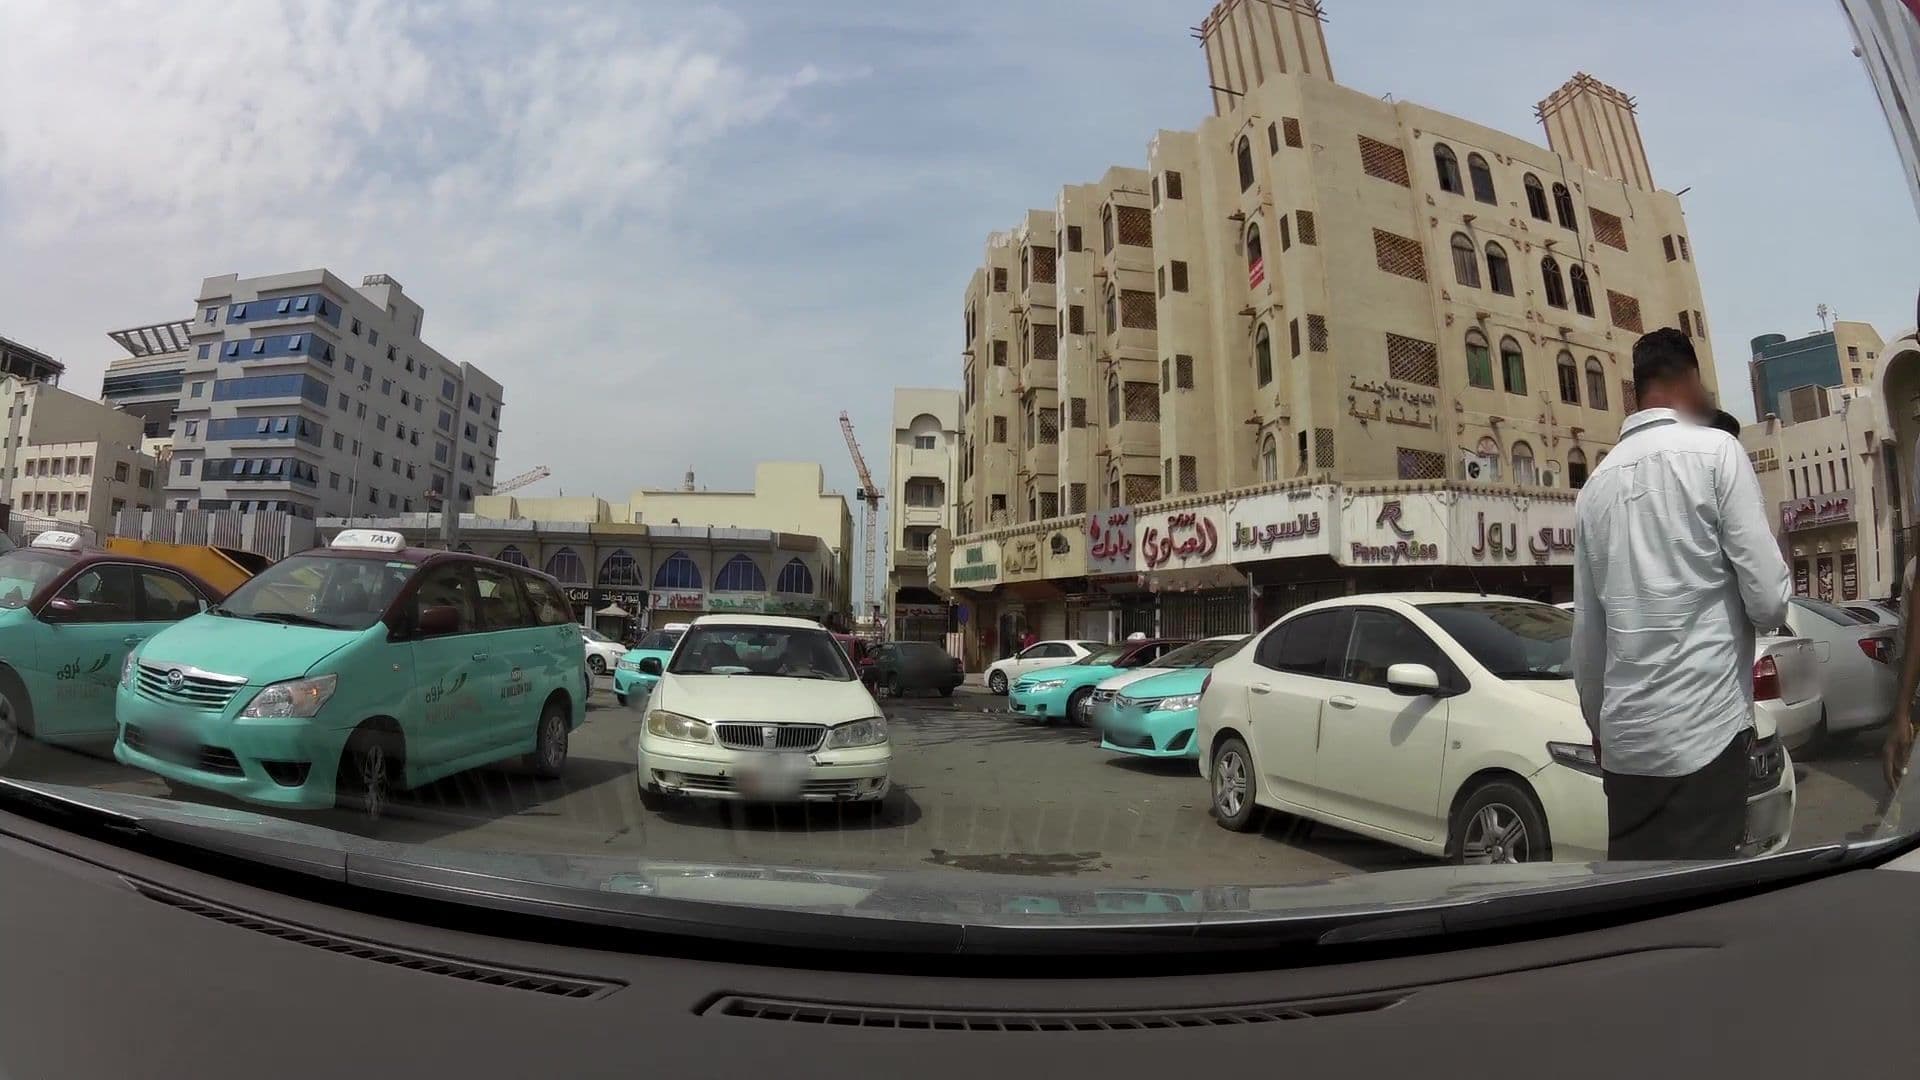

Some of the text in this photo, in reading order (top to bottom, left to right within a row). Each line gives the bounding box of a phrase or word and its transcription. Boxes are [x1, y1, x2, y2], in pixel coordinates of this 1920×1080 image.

[369, 534, 397, 545] TAXI
[1232, 511, 1320, 553] فانسي روز
[1472, 512, 1517, 558] روز
[569, 589, 589, 600] Gold
